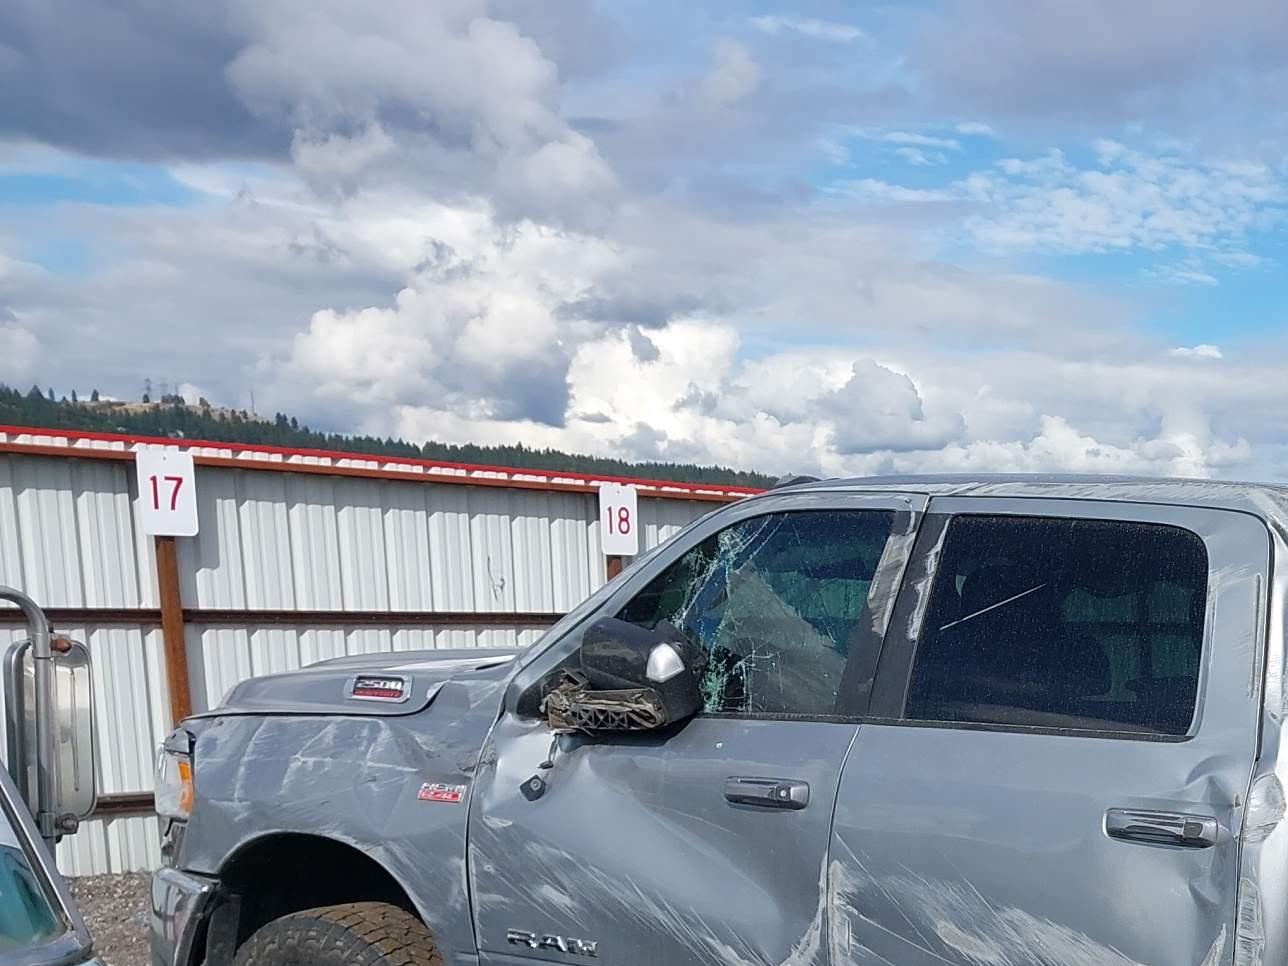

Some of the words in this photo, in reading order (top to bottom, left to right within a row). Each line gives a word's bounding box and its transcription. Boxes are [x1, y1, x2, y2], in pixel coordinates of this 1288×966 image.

[150, 475, 183, 511] 17
[607, 506, 630, 535] 18
[507, 928, 598, 957] RAM
